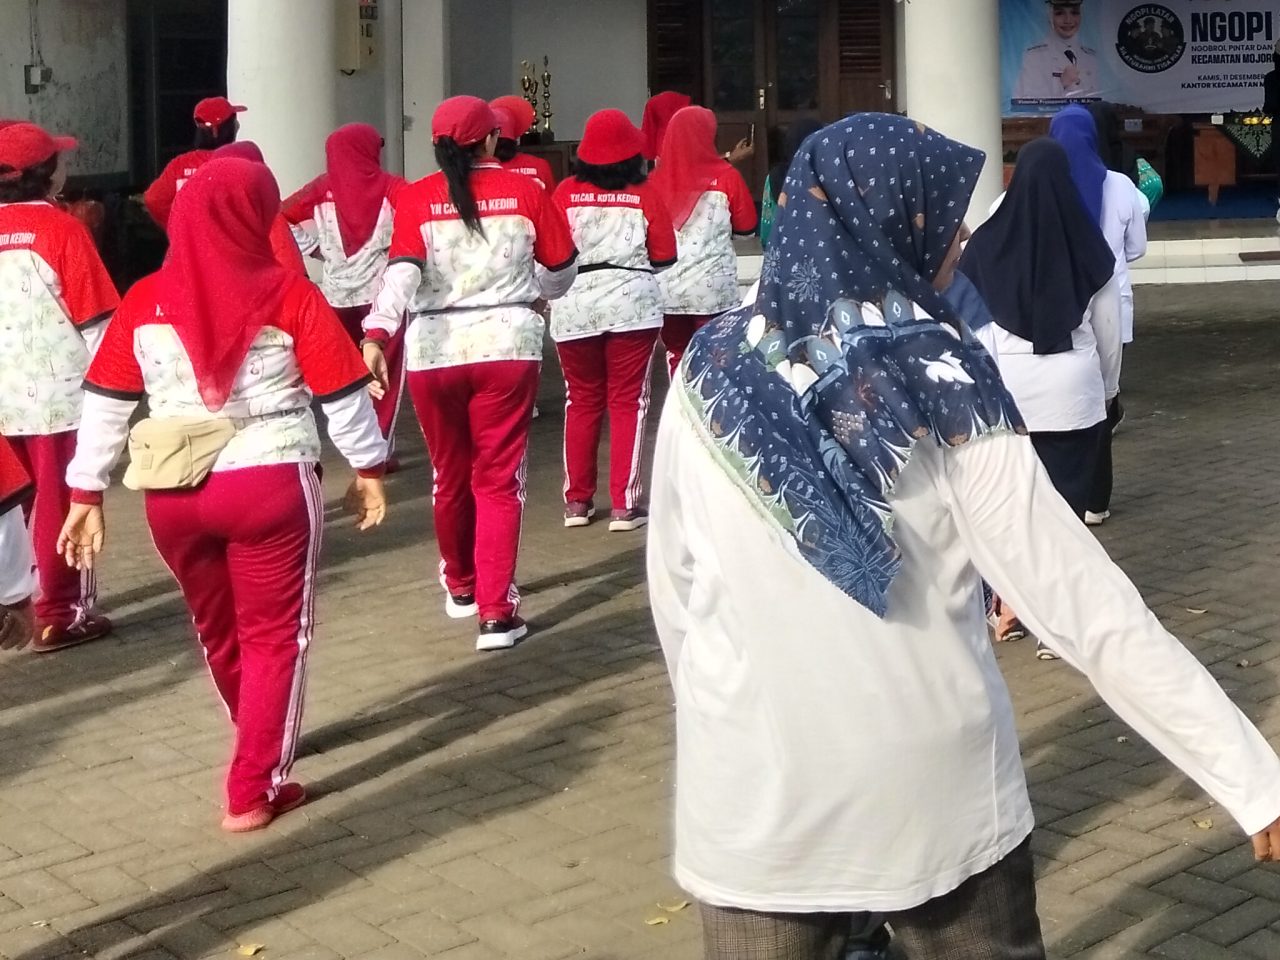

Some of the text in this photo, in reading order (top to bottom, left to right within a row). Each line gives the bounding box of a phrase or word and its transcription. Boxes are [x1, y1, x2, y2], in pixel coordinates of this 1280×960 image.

[1191, 10, 1272, 42] NGOPI
[1191, 53, 1274, 64] KECAMATAN MOJOR
[443, 202, 458, 215] CA
[476, 200, 487, 211] TA
[488, 197, 518, 211] KEDIRI
[580, 193, 596, 202] CAB.
[597, 193, 615, 202] KOTA
[617, 194, 640, 205] KEDIRI
